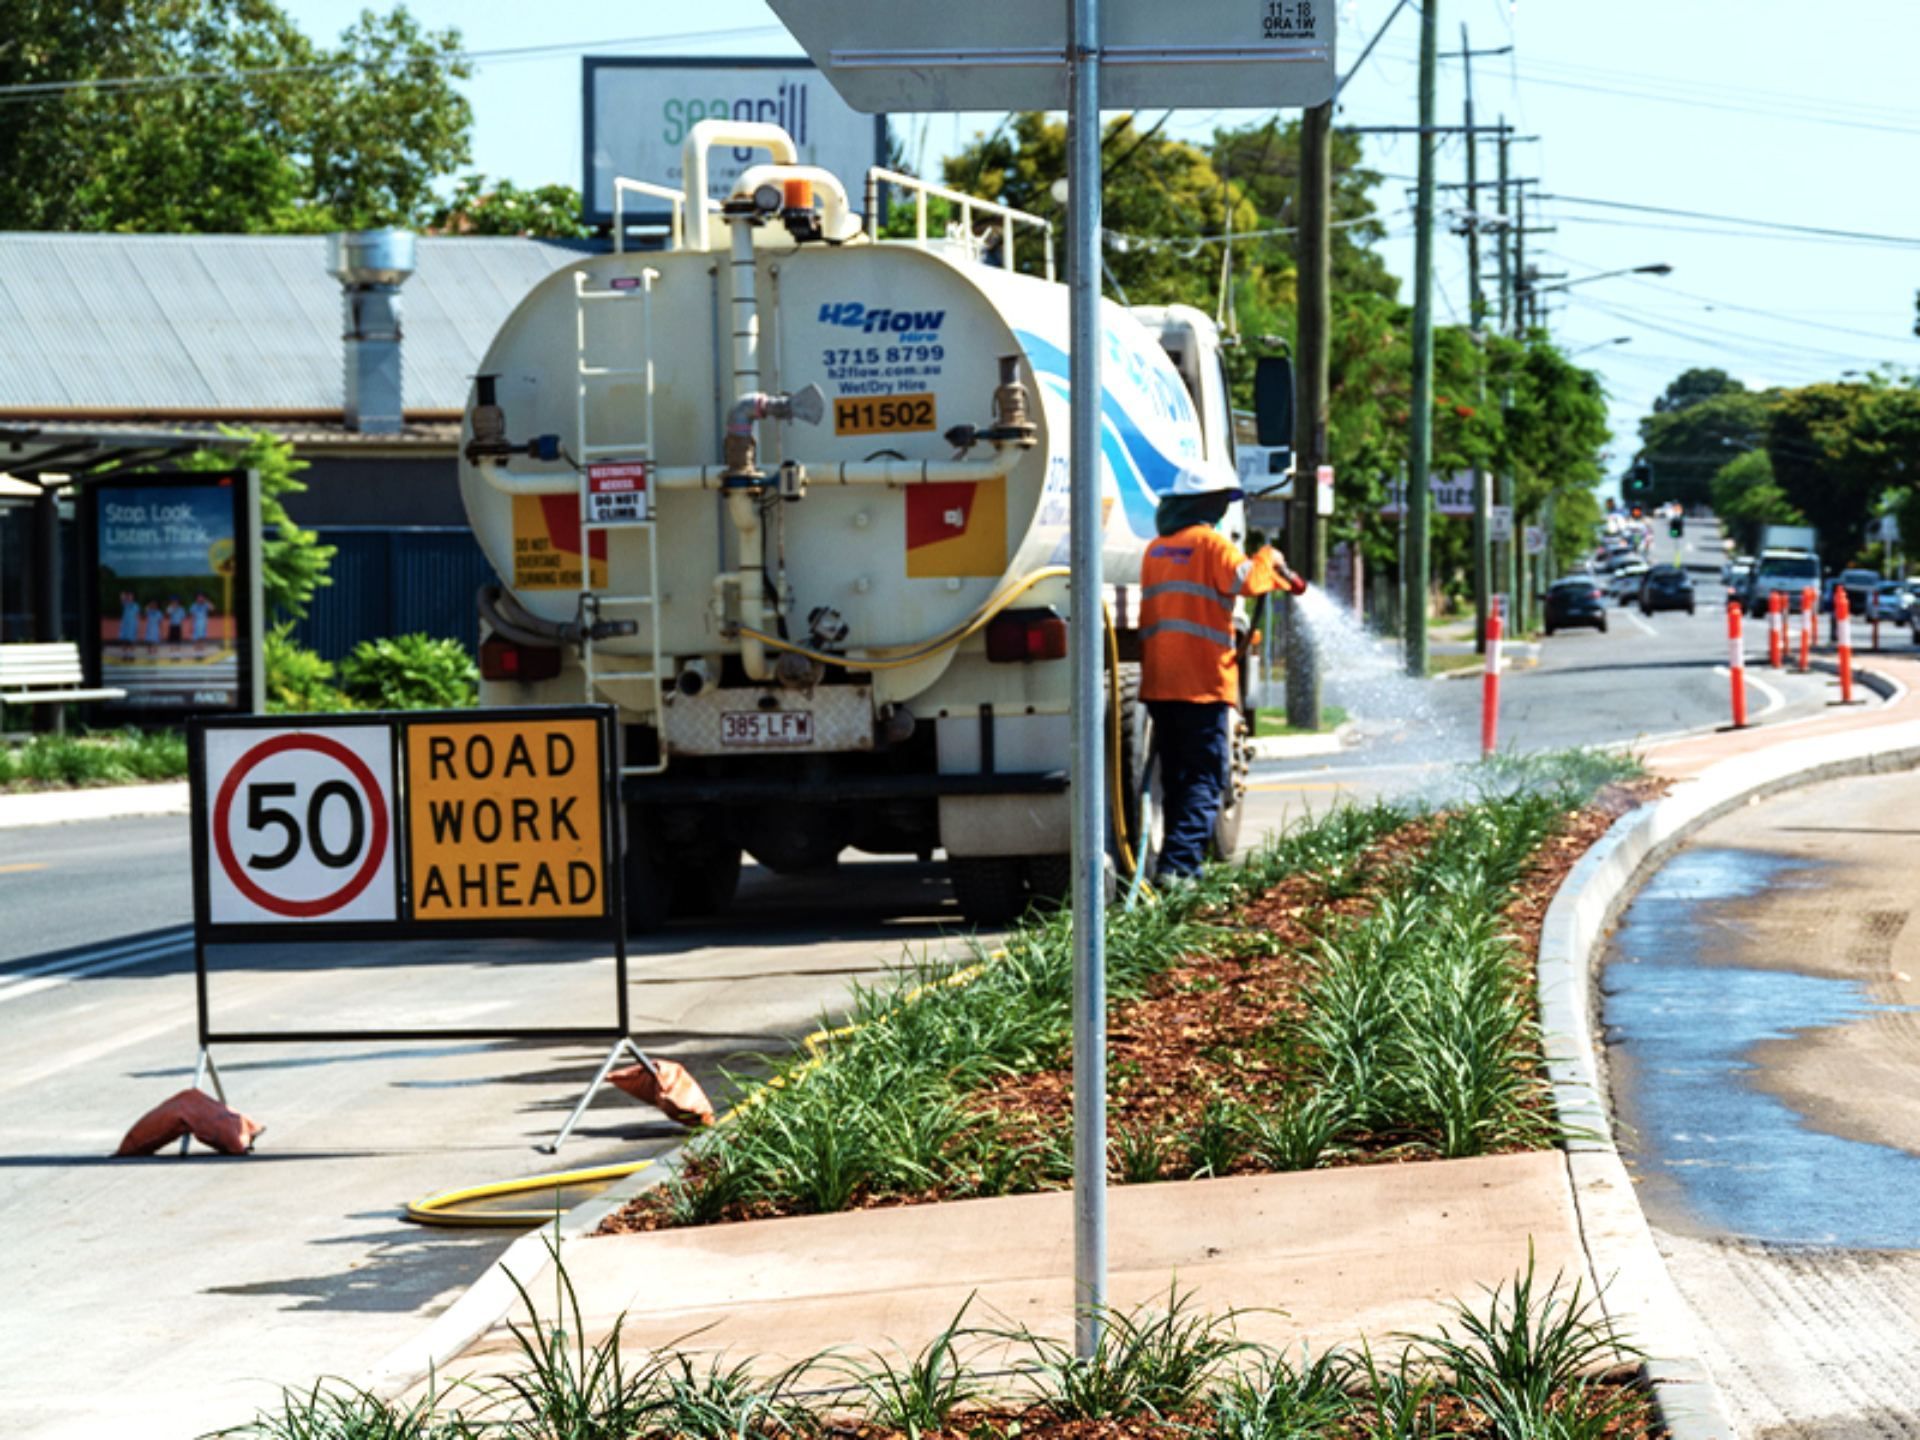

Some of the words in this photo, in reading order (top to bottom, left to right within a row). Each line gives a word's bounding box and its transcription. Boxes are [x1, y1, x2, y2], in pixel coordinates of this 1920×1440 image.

[823, 349, 880, 366] 3715
[886, 345, 944, 363] 8799
[828, 365, 942, 380] h2flow.com.au
[897, 379, 928, 392] Hire
[837, 400, 932, 428] H1502
[725, 716, 760, 737] 385
[767, 714, 808, 736] LFW
[429, 732, 575, 780] ROAD
[247, 780, 365, 870] 50
[430, 797, 580, 844] WORK
[420, 861, 597, 909] AHEAD
